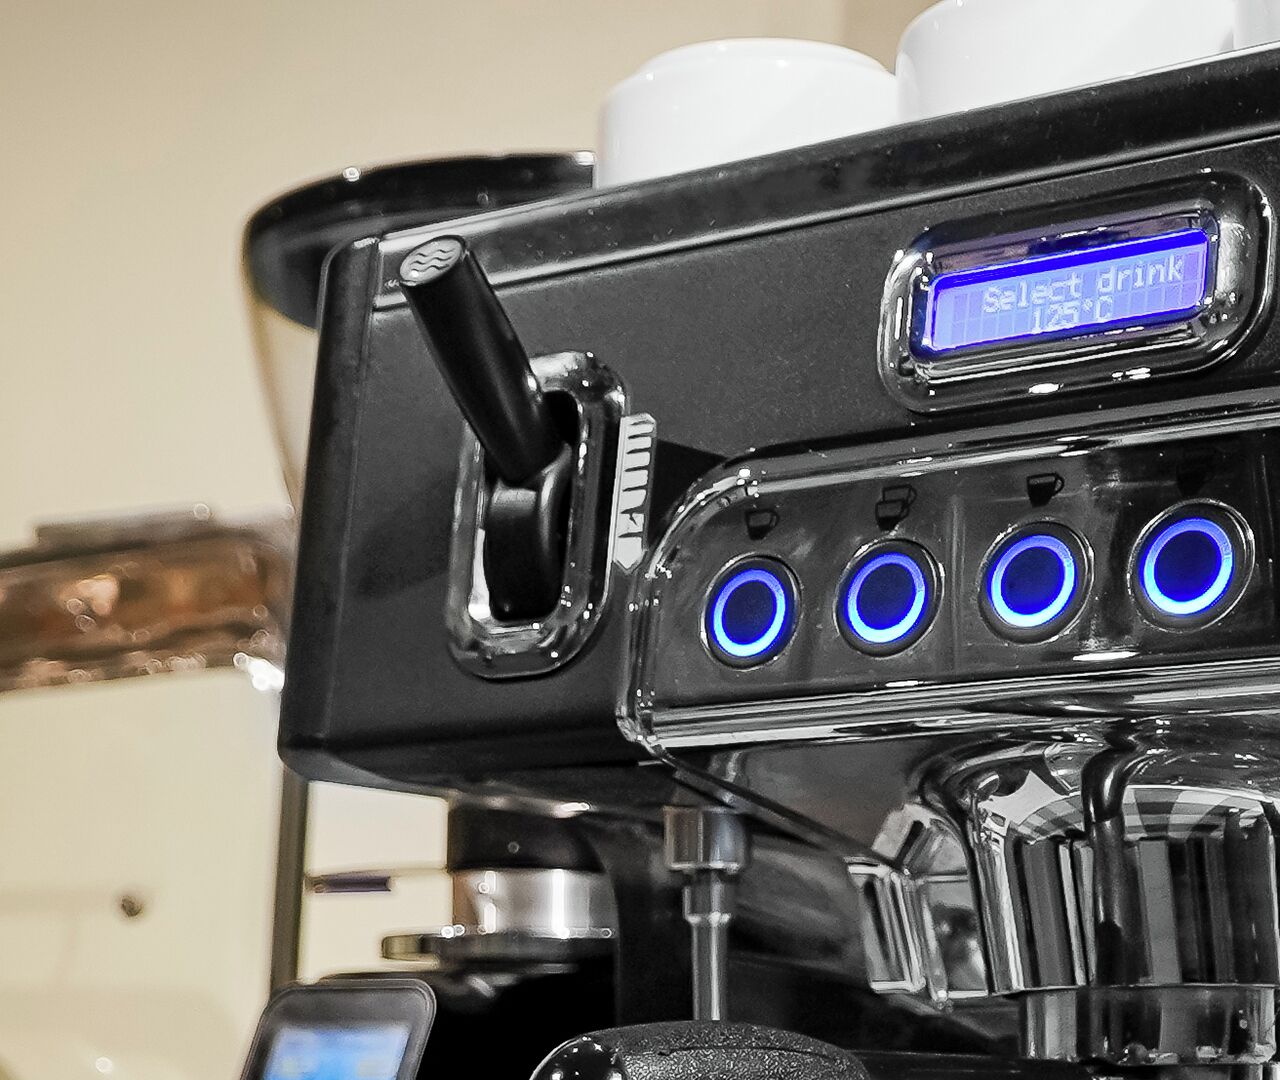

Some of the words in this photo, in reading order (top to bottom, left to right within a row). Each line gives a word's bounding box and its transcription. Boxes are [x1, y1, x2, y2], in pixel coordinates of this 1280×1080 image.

[983, 272, 1084, 313] Select
[1097, 254, 1186, 294] drink
[1032, 296, 1114, 332] 125°C
